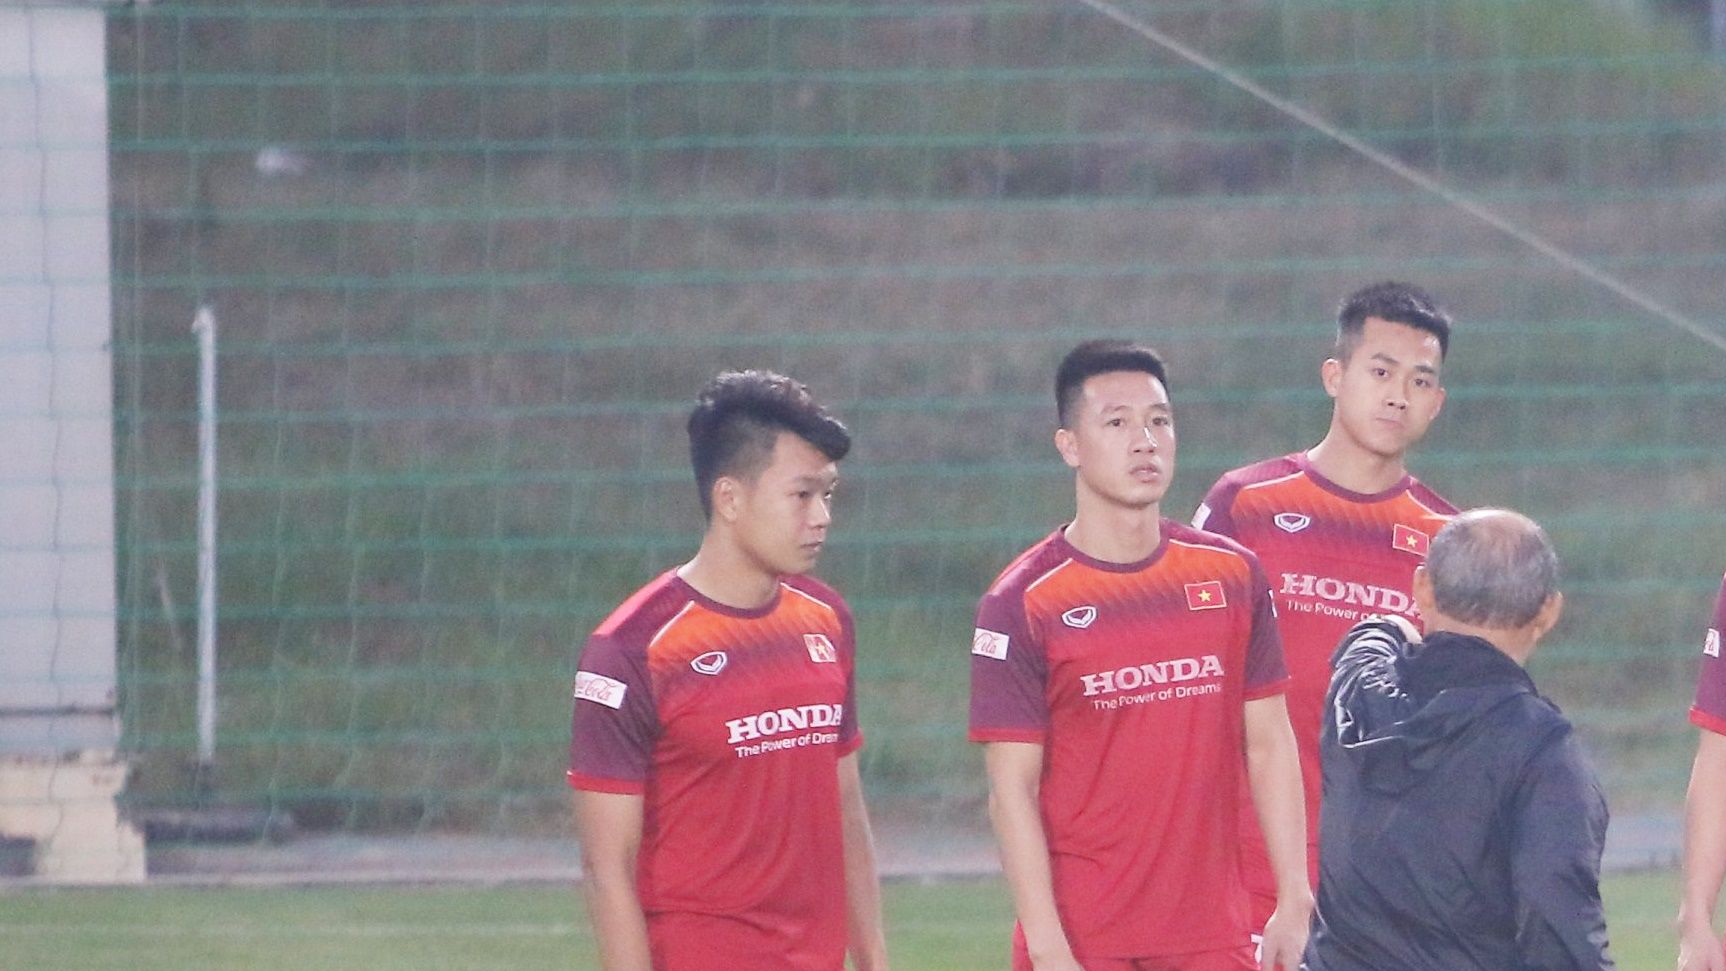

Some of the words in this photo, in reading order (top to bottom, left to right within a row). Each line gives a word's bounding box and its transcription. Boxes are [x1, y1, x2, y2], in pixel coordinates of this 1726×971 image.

[1287, 600, 1313, 613] The
[1315, 602, 1357, 620] Power
[1080, 655, 1225, 697] HONDA
[1094, 699, 1118, 711] The
[1119, 691, 1156, 707] Power
[1158, 688, 1173, 701] of
[1176, 682, 1223, 698] Dreams
[725, 703, 842, 744] HONDA
[735, 744, 760, 758] The
[761, 737, 796, 753] Power
[797, 733, 810, 747] of
